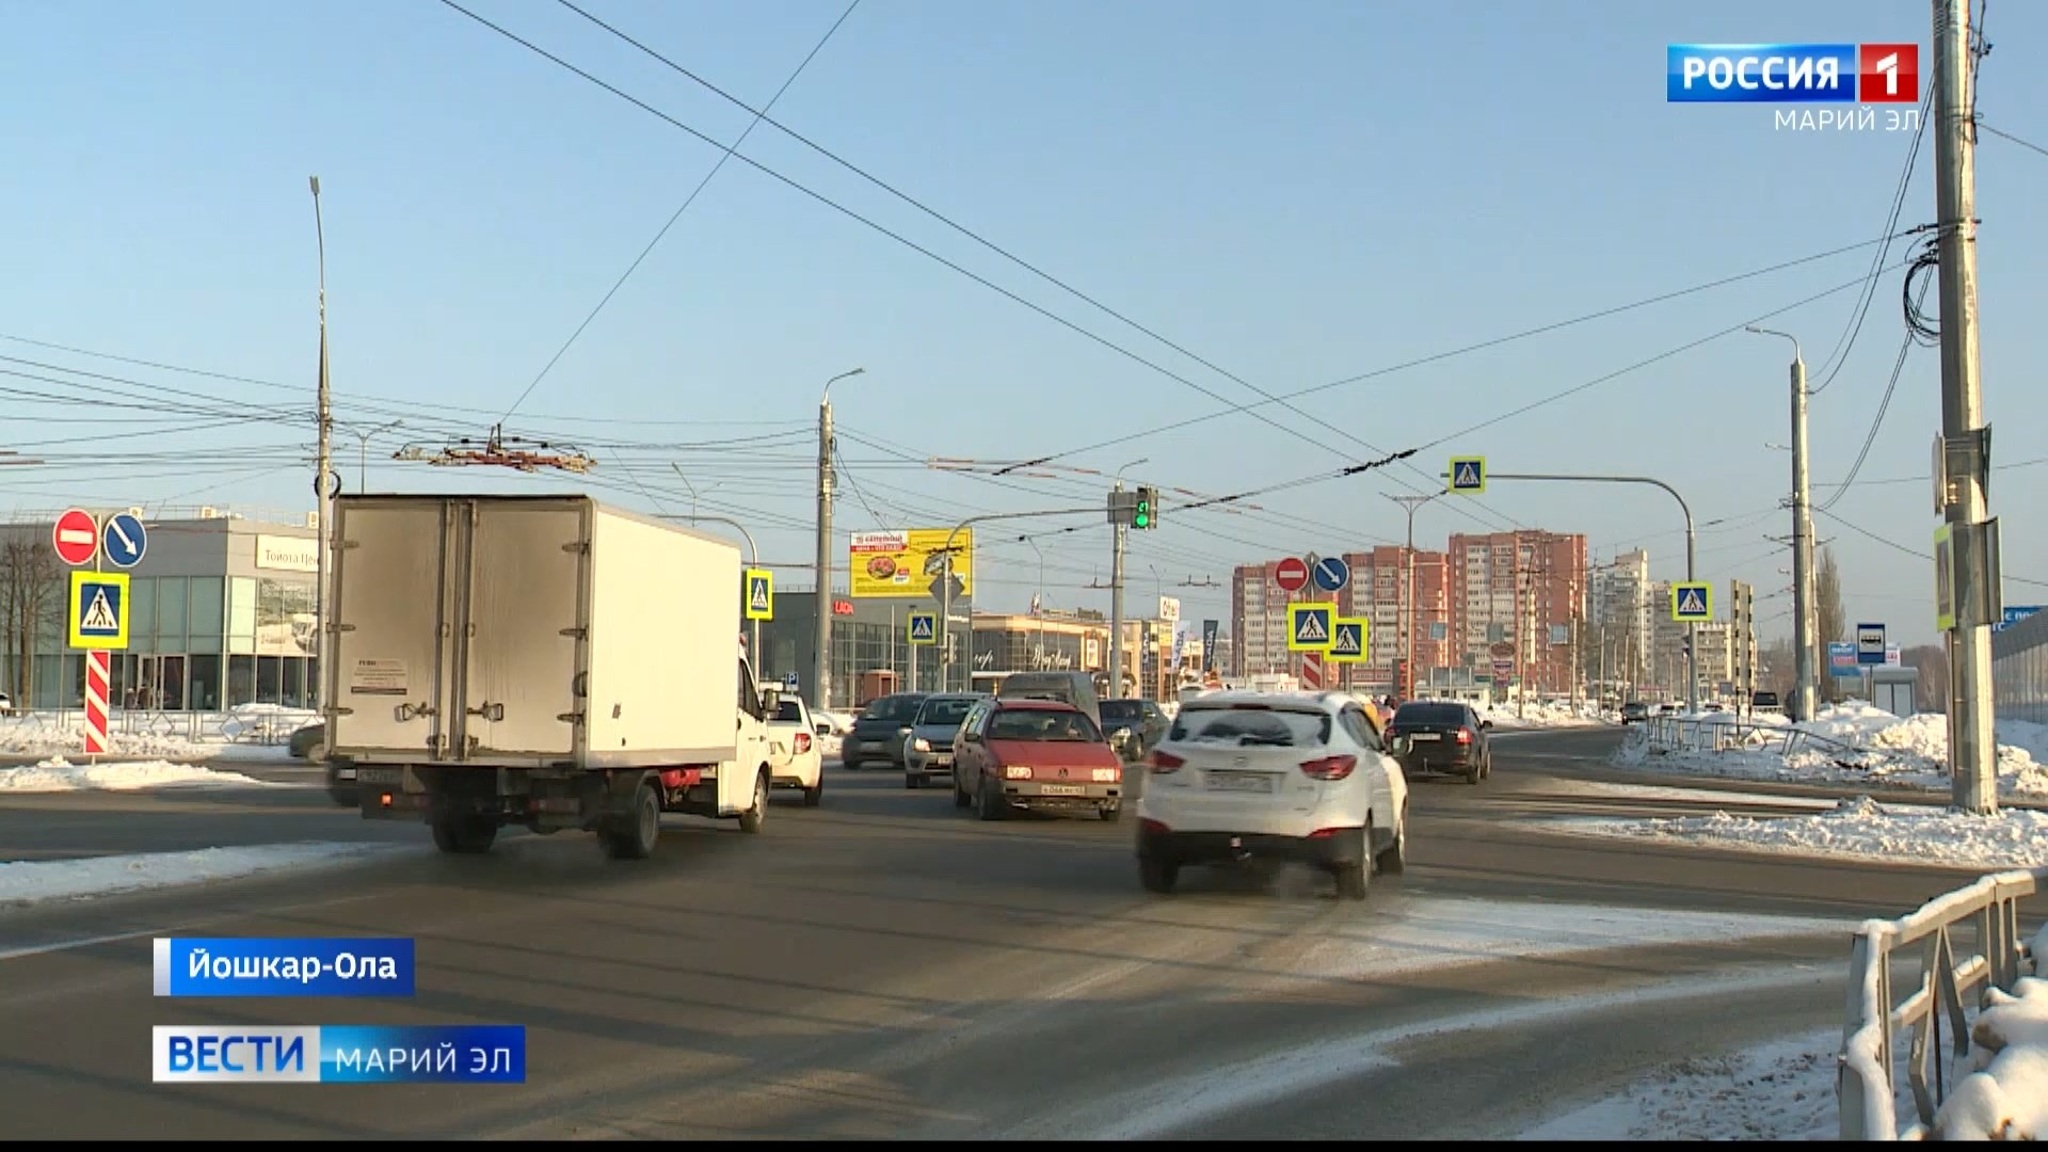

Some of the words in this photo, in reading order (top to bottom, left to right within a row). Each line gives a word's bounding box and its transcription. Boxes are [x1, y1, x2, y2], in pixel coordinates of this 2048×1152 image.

[266, 549, 299, 563] Тойота
[835, 600, 854, 615] LADA
[1174, 630, 1185, 662] LADA
